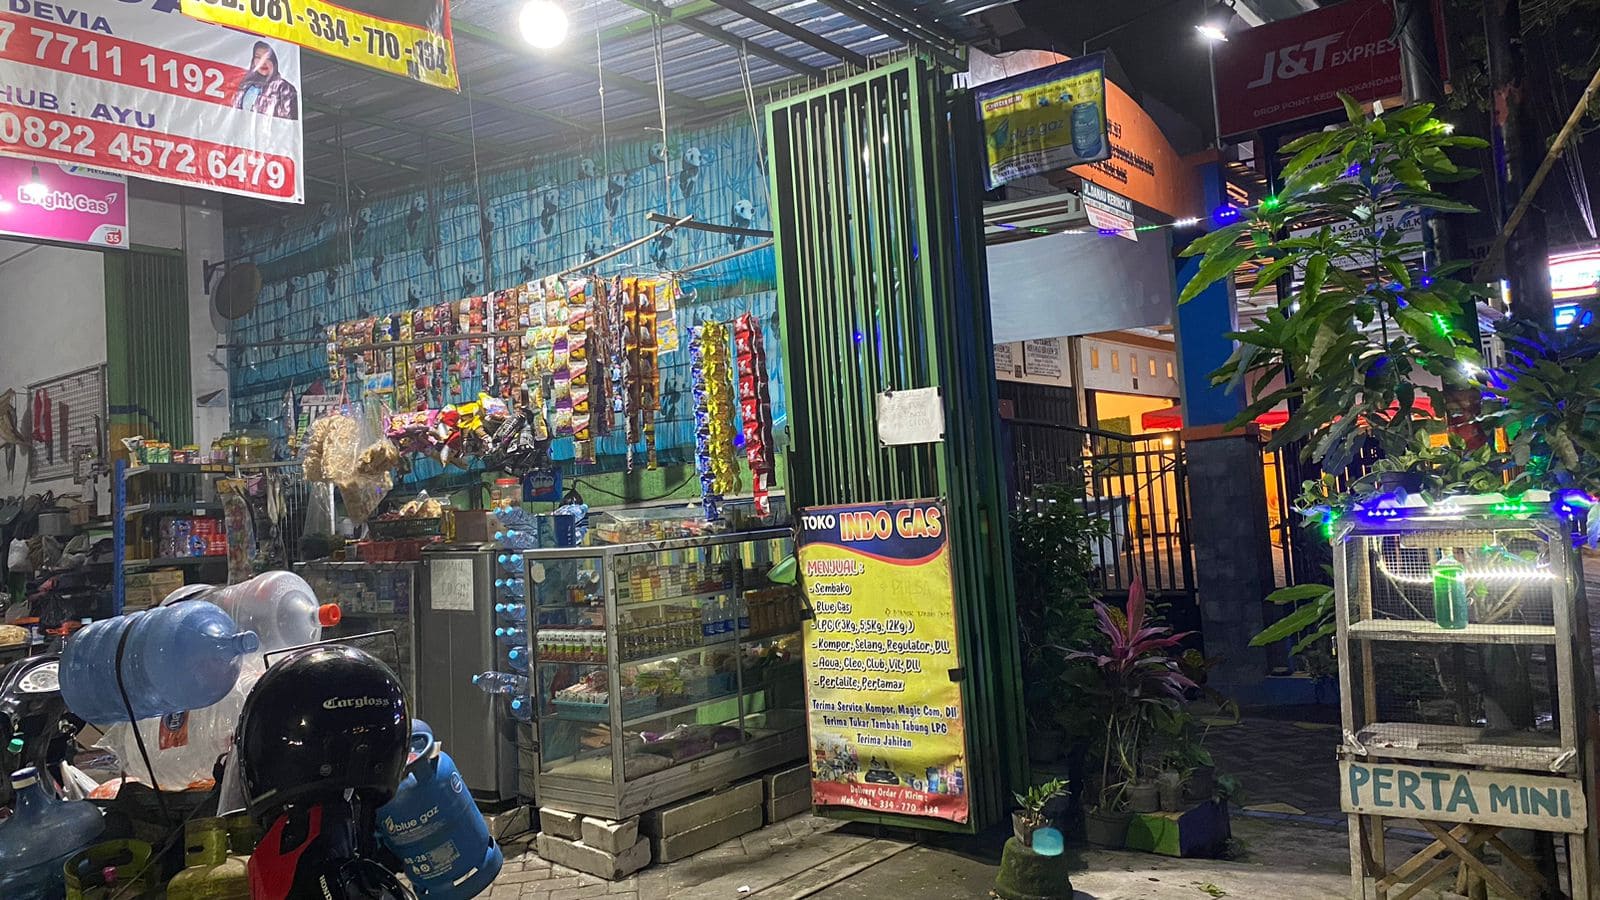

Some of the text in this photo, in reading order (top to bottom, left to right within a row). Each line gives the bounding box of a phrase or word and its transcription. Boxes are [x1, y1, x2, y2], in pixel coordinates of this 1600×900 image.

[9, 0, 113, 34] DEVIA
[309, 10, 349, 46] 334
[363, 26, 400, 60] 770
[30, 27, 122, 76] 7711
[140, 54, 225, 98] 1192
[1247, 32, 1345, 88] J&T
[90, 103, 156, 128] AYU
[1254, 104, 1280, 117] DROP
[1282, 97, 1310, 109] POINT
[0, 111, 285, 189] 0822 4572 6479
[19, 185, 107, 215] bght Gas
[802, 507, 942, 541] TOKO INDO GAS
[807, 560, 857, 576] MENJUAL
[815, 582, 851, 595] Sembako
[816, 601, 851, 613] Blue Gas
[817, 619, 834, 631] LPG
[862, 676, 905, 691] Pertamax
[323, 696, 389, 709] Cargloss
[812, 700, 835, 711] Terima
[837, 701, 863, 712] Service
[898, 705, 920, 718] Magic
[823, 716, 947, 735] Terima Tukar Tambah Tabung LPG
[857, 733, 912, 748] Terima Jahitan
[850, 784, 876, 798] Delivery
[878, 787, 896, 799] Order
[1350, 764, 1571, 818] PERTA MINI
[395, 819, 417, 832] blue
[419, 806, 440, 824] gaz
